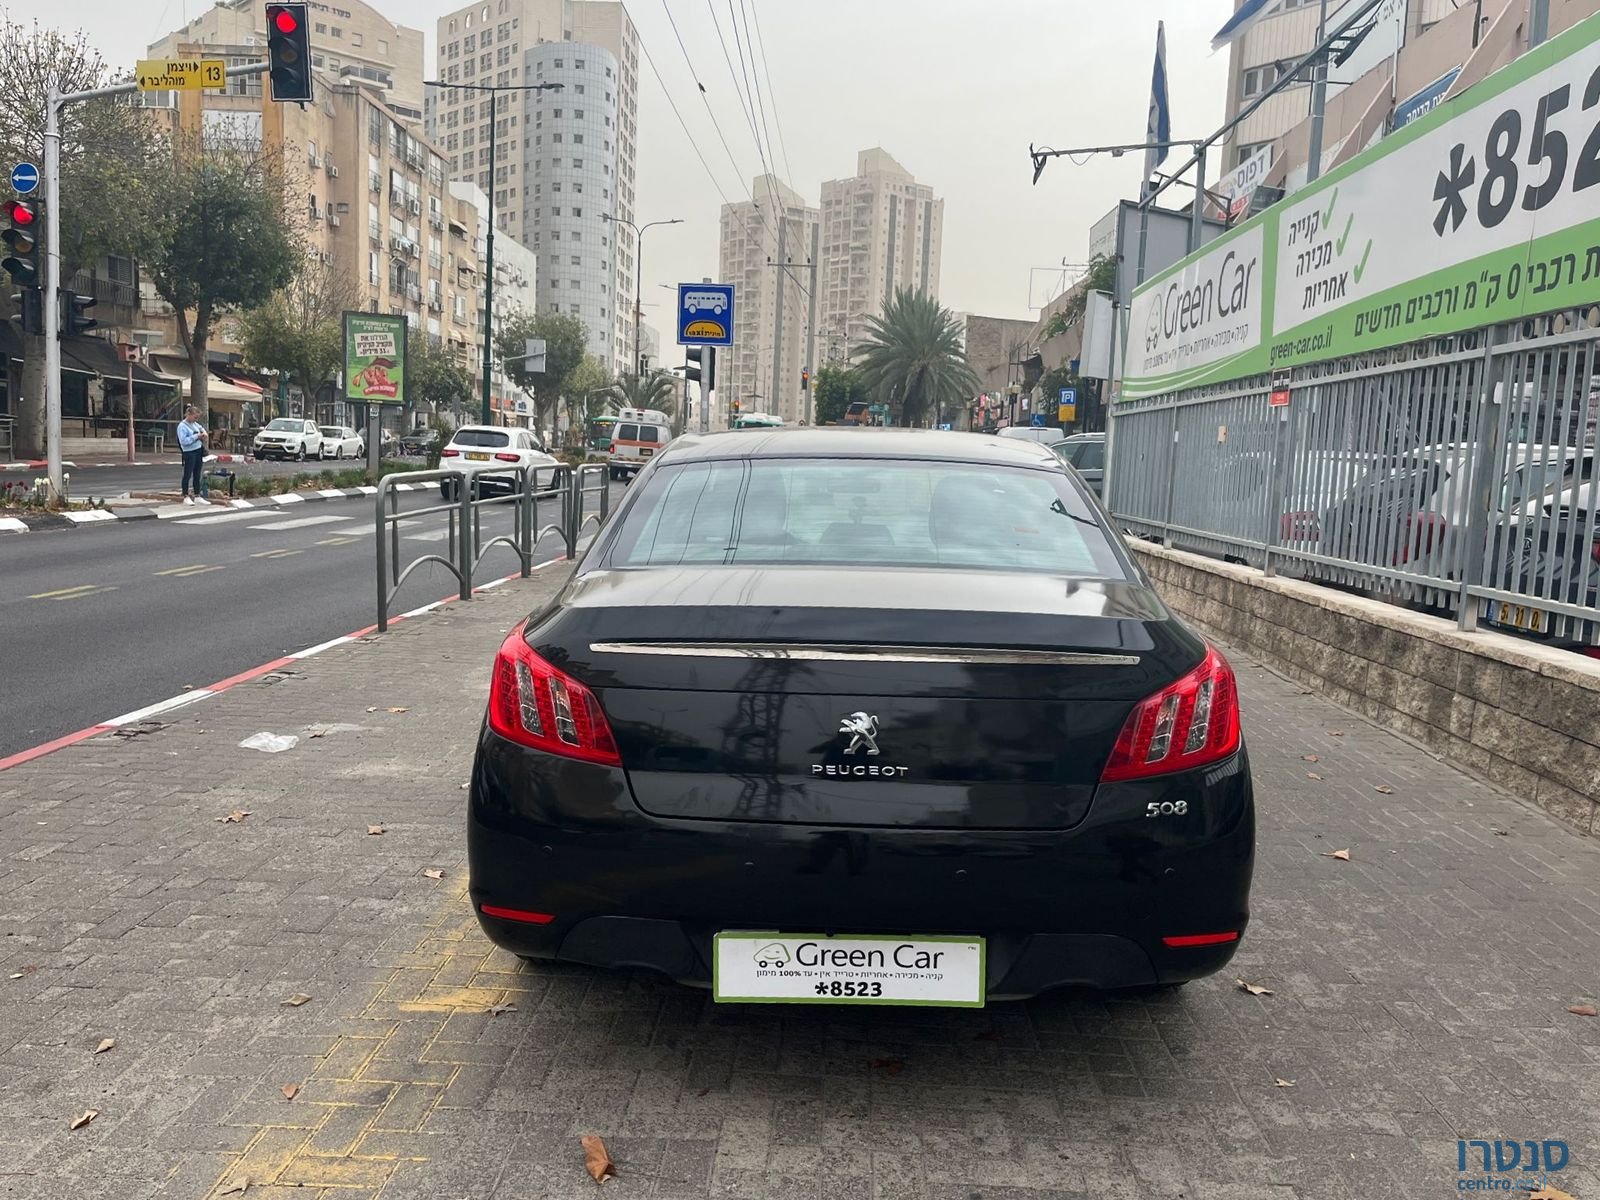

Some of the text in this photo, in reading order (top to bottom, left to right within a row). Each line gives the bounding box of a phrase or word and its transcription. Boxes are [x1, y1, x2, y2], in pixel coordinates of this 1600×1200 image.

[148, 74, 185, 86] מוהליבר
[167, 63, 192, 75] ויצמן
[206, 66, 221, 81] 13
[1237, 154, 1264, 188] דפוס
[1288, 210, 1320, 246] קנייה
[1296, 240, 1332, 278] מכירה
[1527, 253, 1576, 294] רכבי
[1164, 250, 1257, 340] Green Car
[1302, 271, 1348, 311] אחריות
[1507, 263, 1521, 300] 0
[1354, 302, 1401, 337] חדשים
[1405, 286, 1459, 324] ורכבים
[1270, 324, 1333, 366] green-car.co.il
[811, 764, 909, 777] PEUGEOT
[1145, 800, 1188, 818] 508
[796, 942, 945, 970] Green Car
[756, 970, 777, 978] מימון
[819, 970, 831, 978] אין
[860, 971, 889, 979] אחריות
[925, 973, 943, 981] קניה
